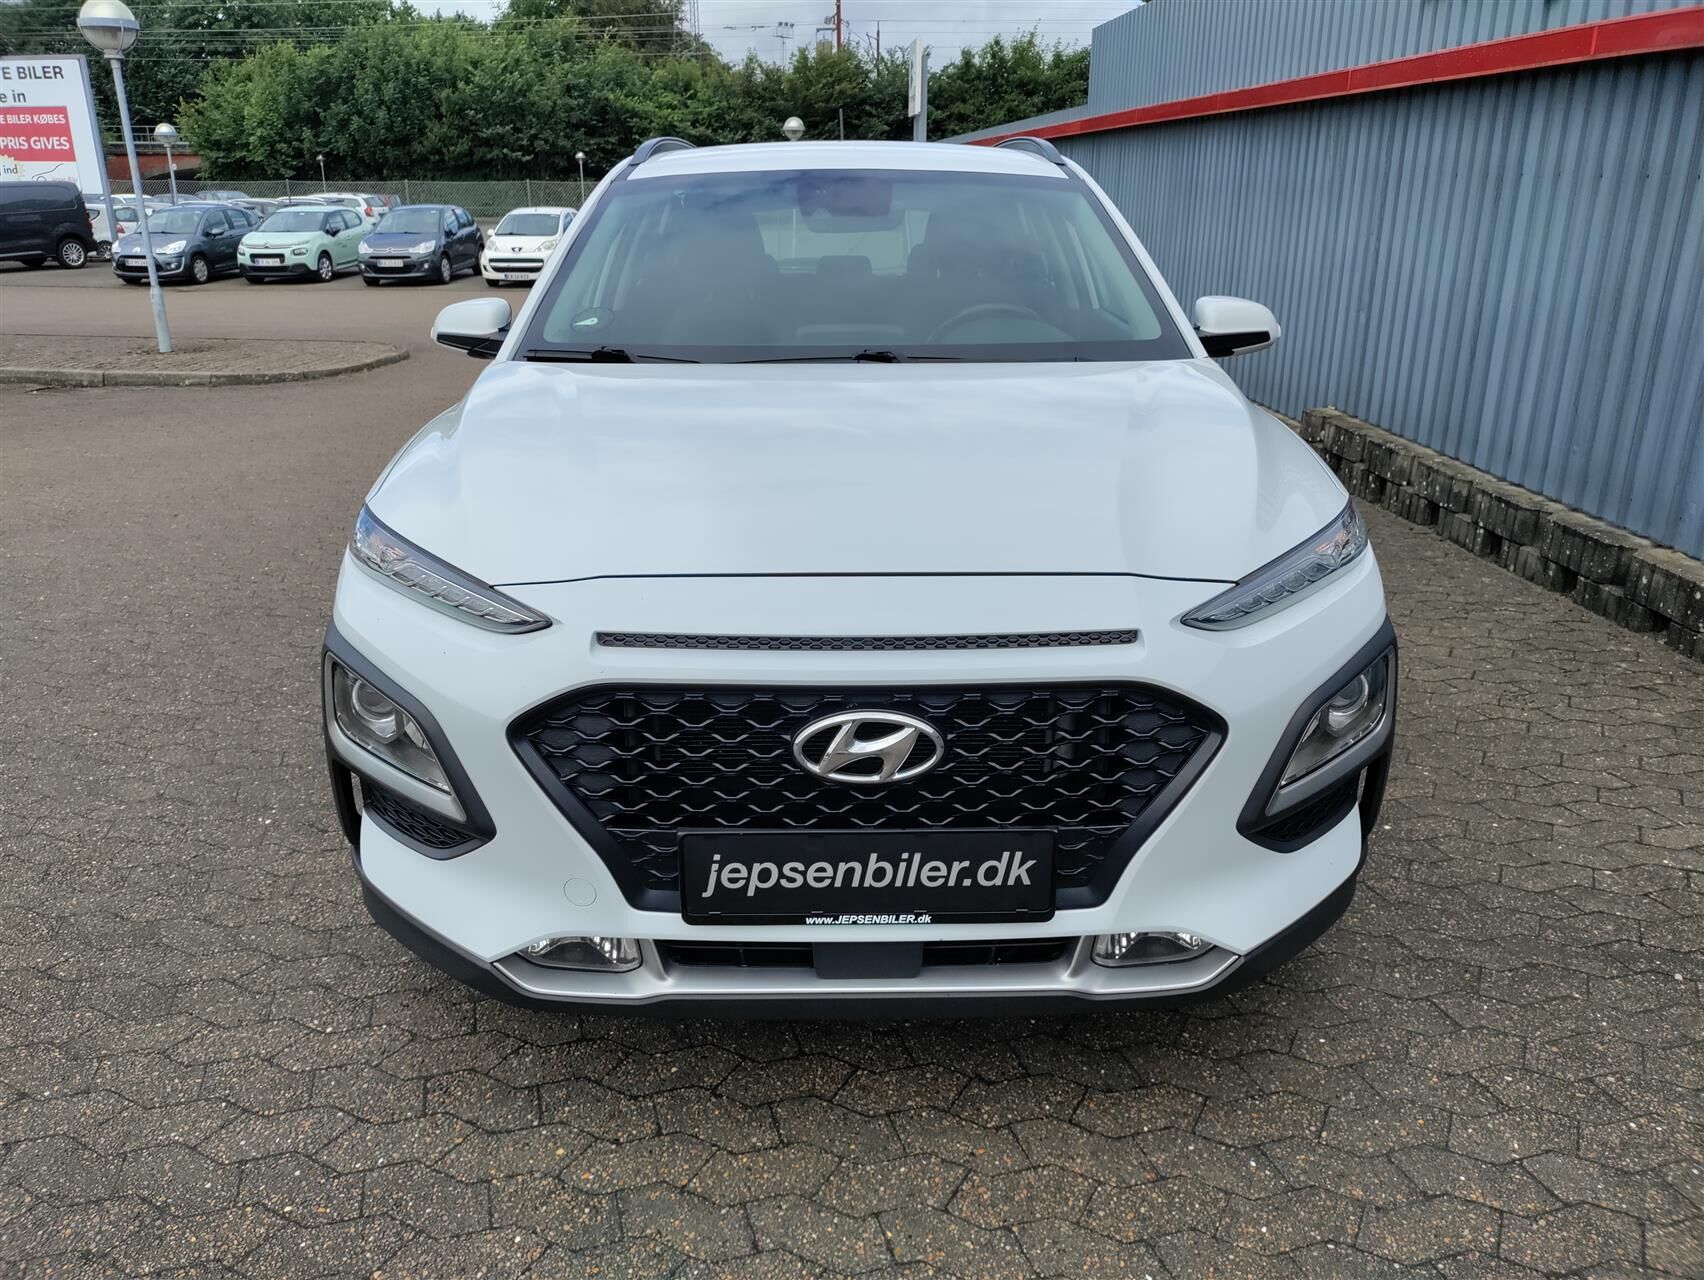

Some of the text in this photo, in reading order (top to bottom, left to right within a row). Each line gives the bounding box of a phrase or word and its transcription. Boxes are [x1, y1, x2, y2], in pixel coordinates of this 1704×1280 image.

[16, 66, 64, 80] BILER
[12, 89, 26, 103] in
[7, 114, 32, 124] BILER
[33, 114, 66, 124] KØBES
[31, 137, 70, 149] GIVES
[3, 164, 18, 174] ind
[703, 851, 1037, 898] jepsenbiler.dk
[805, 914, 932, 925] www.JEPSENBILER.dk
